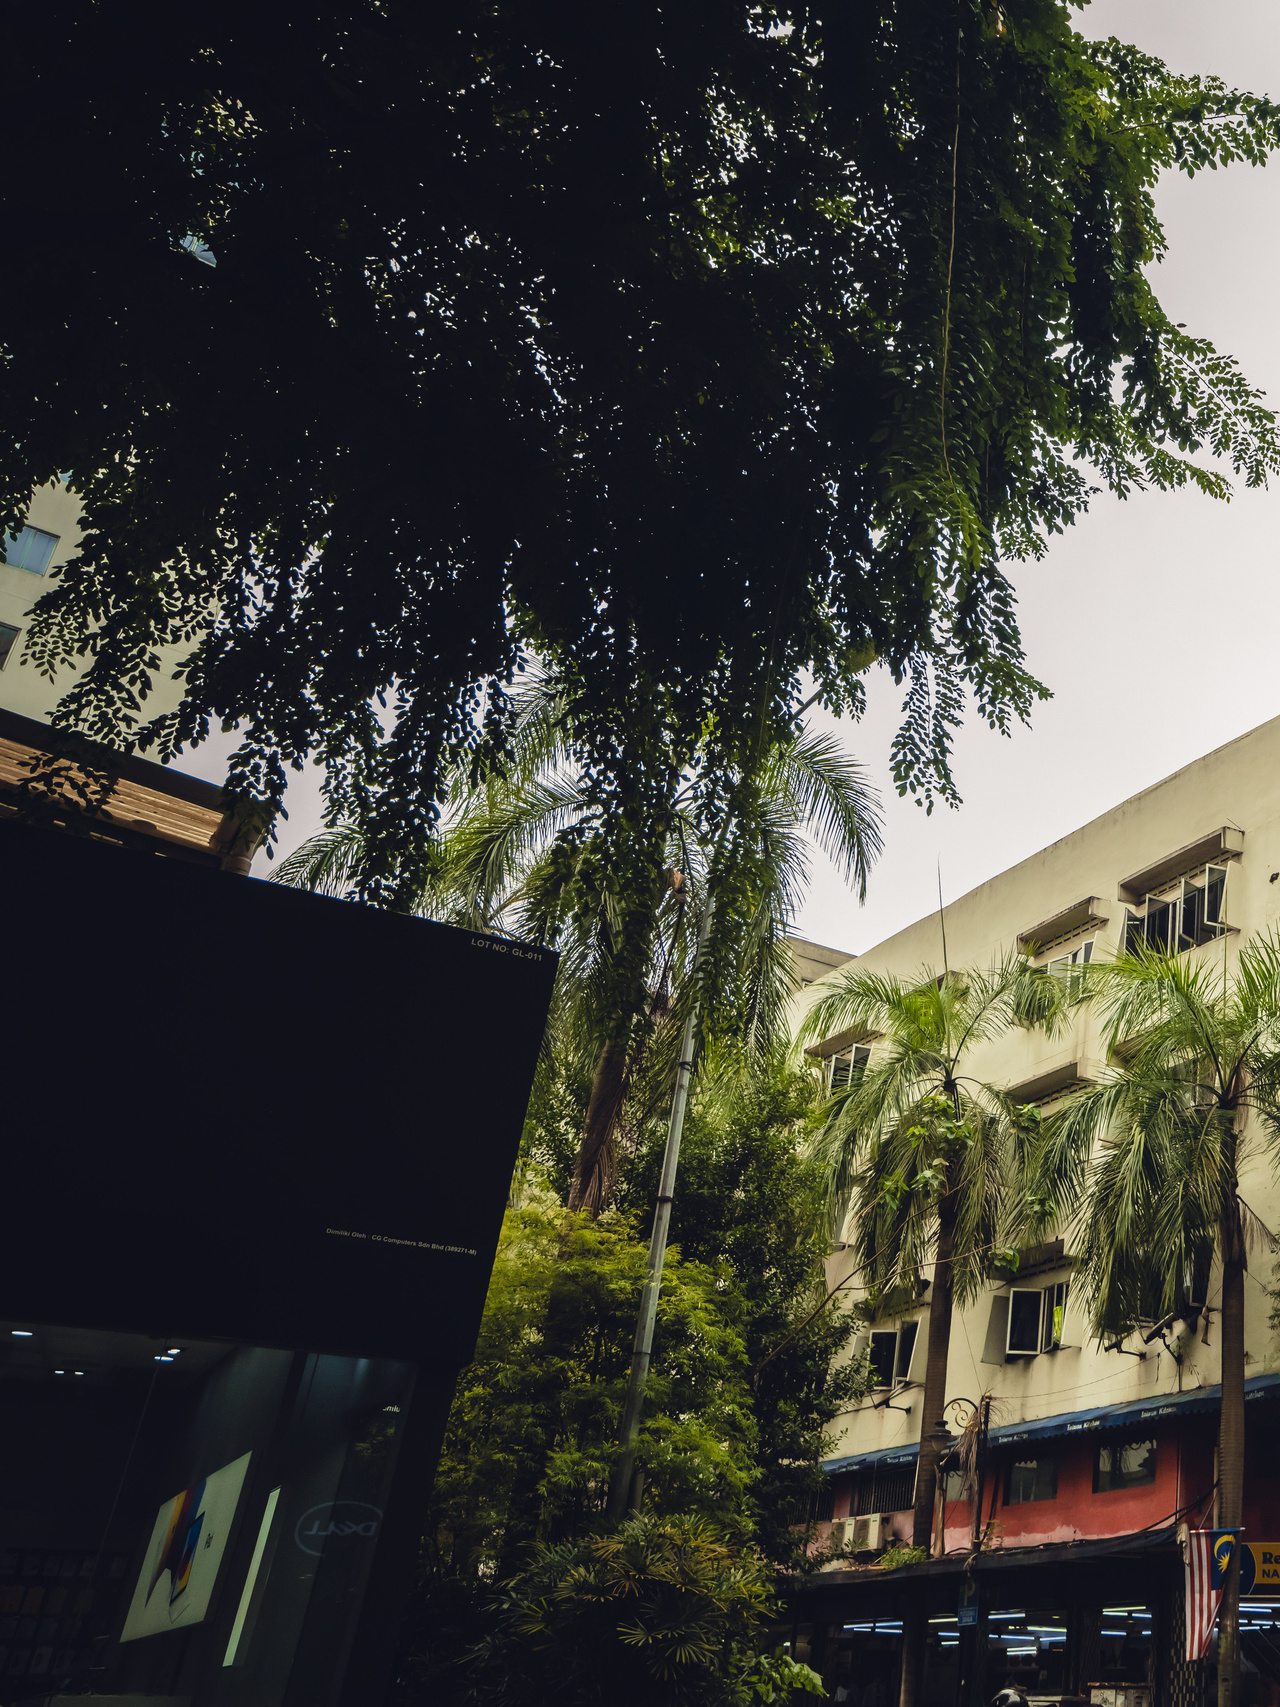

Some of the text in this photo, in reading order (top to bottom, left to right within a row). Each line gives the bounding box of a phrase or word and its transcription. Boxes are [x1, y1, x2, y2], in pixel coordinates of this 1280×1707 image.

[471, 938, 542, 961] LOT NO: GL-011
[326, 1228, 351, 1237] Dimiliki
[351, 1231, 367, 1239] Oleh
[383, 1236, 417, 1247] Computers
[418, 1241, 430, 1249] Sdn
